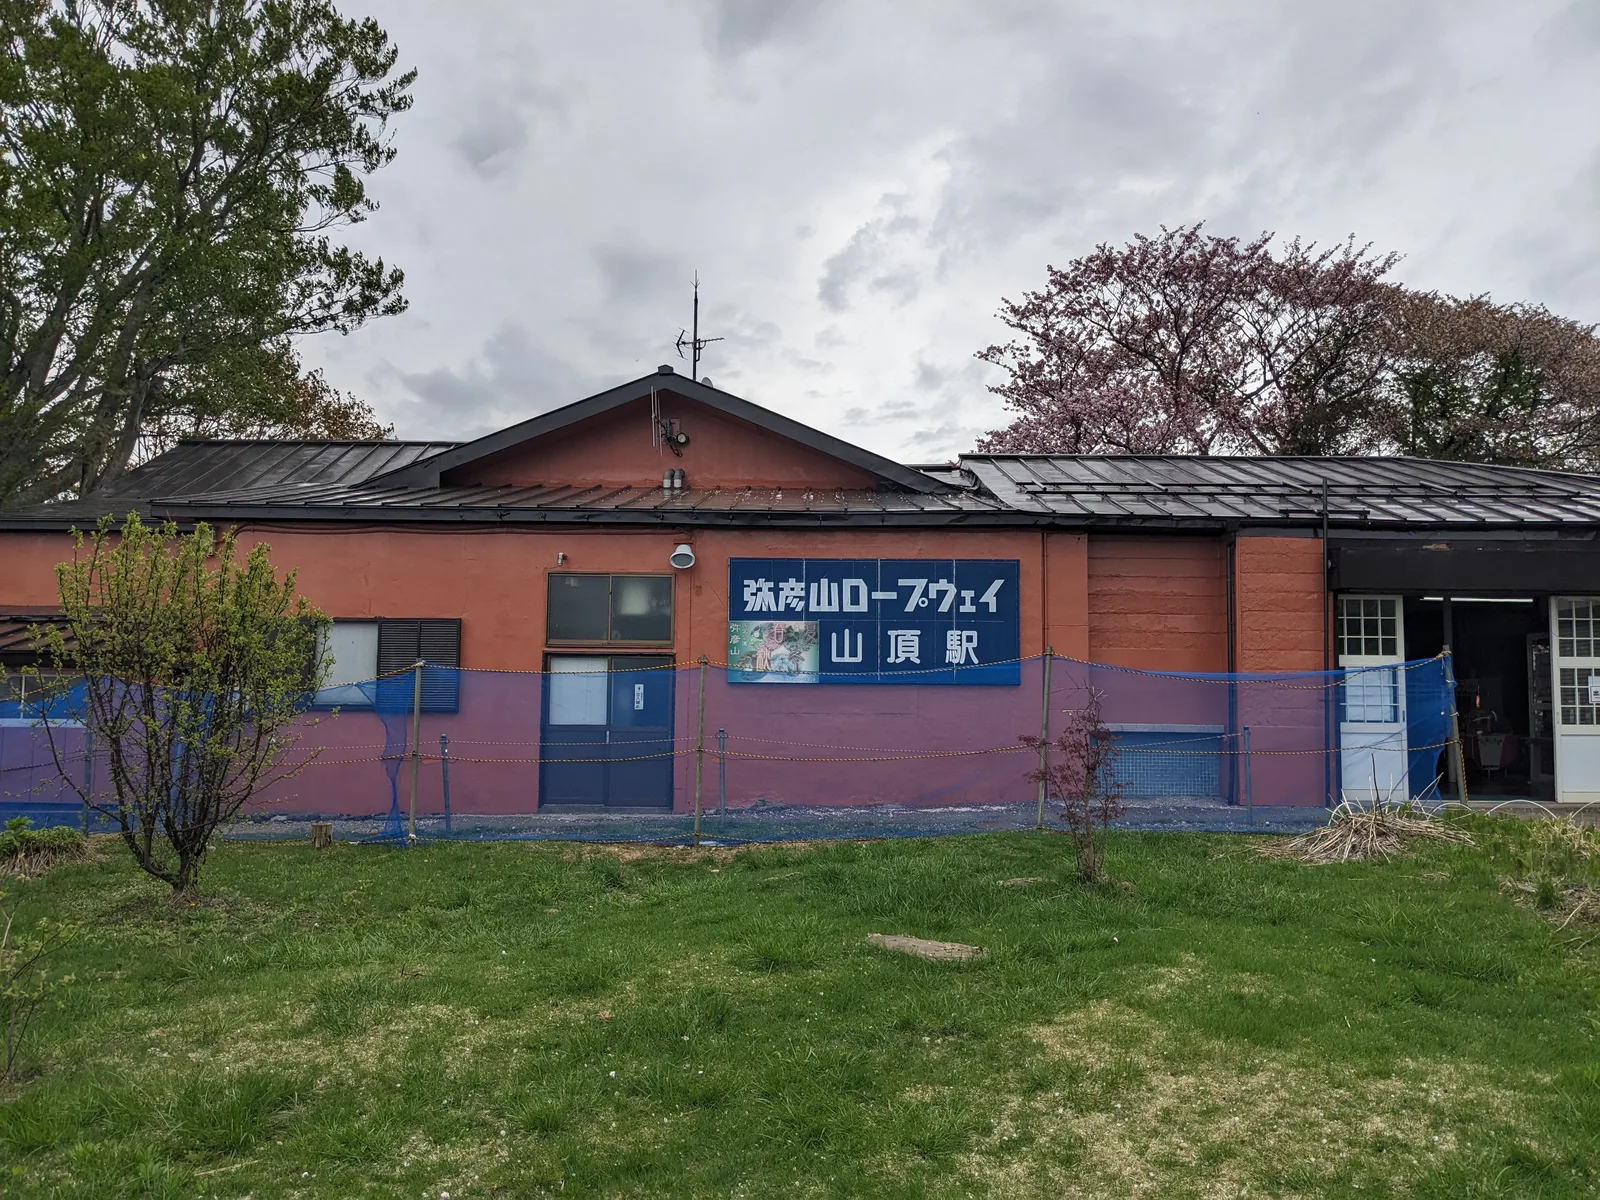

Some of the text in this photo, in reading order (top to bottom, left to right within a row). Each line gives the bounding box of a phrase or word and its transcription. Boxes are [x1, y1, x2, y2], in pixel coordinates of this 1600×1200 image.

[743, 577, 1005, 613] 弥彦山ロープウェイ
[831, 628, 979, 665] 山頂駅
